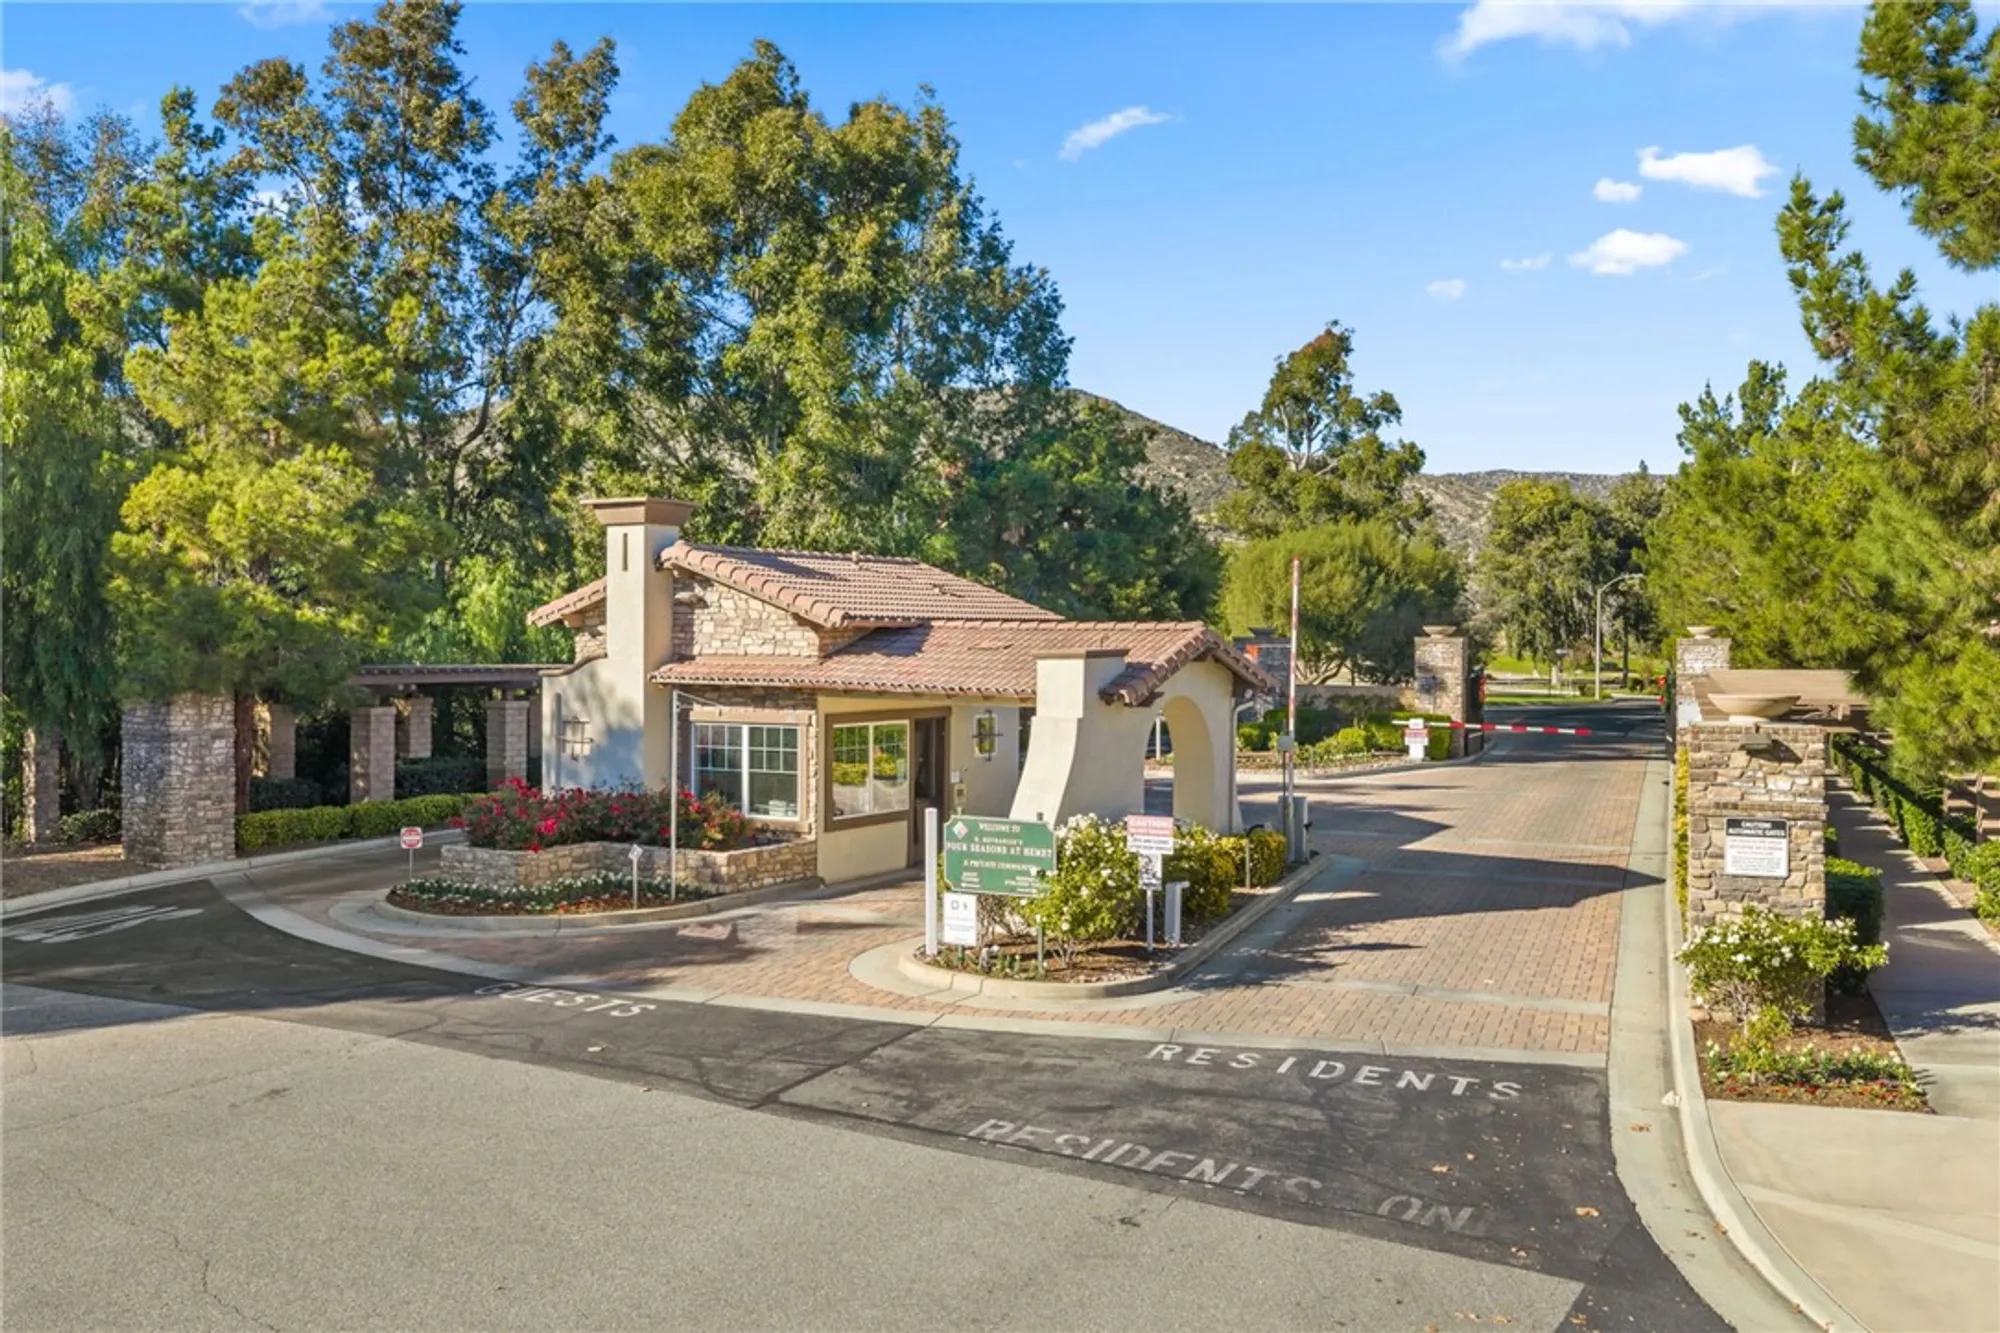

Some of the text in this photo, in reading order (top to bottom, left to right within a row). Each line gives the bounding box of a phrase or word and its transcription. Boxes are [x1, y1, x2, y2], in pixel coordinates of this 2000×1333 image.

[947, 841, 967, 852] FOUR
[970, 843, 1007, 855] SEASONS
[1010, 846, 1021, 855] AT
[474, 982, 656, 1017] GUESTS
[1144, 1043, 1521, 1100] RESIDENTS
[962, 1118, 1323, 1203] RESIDENTS
